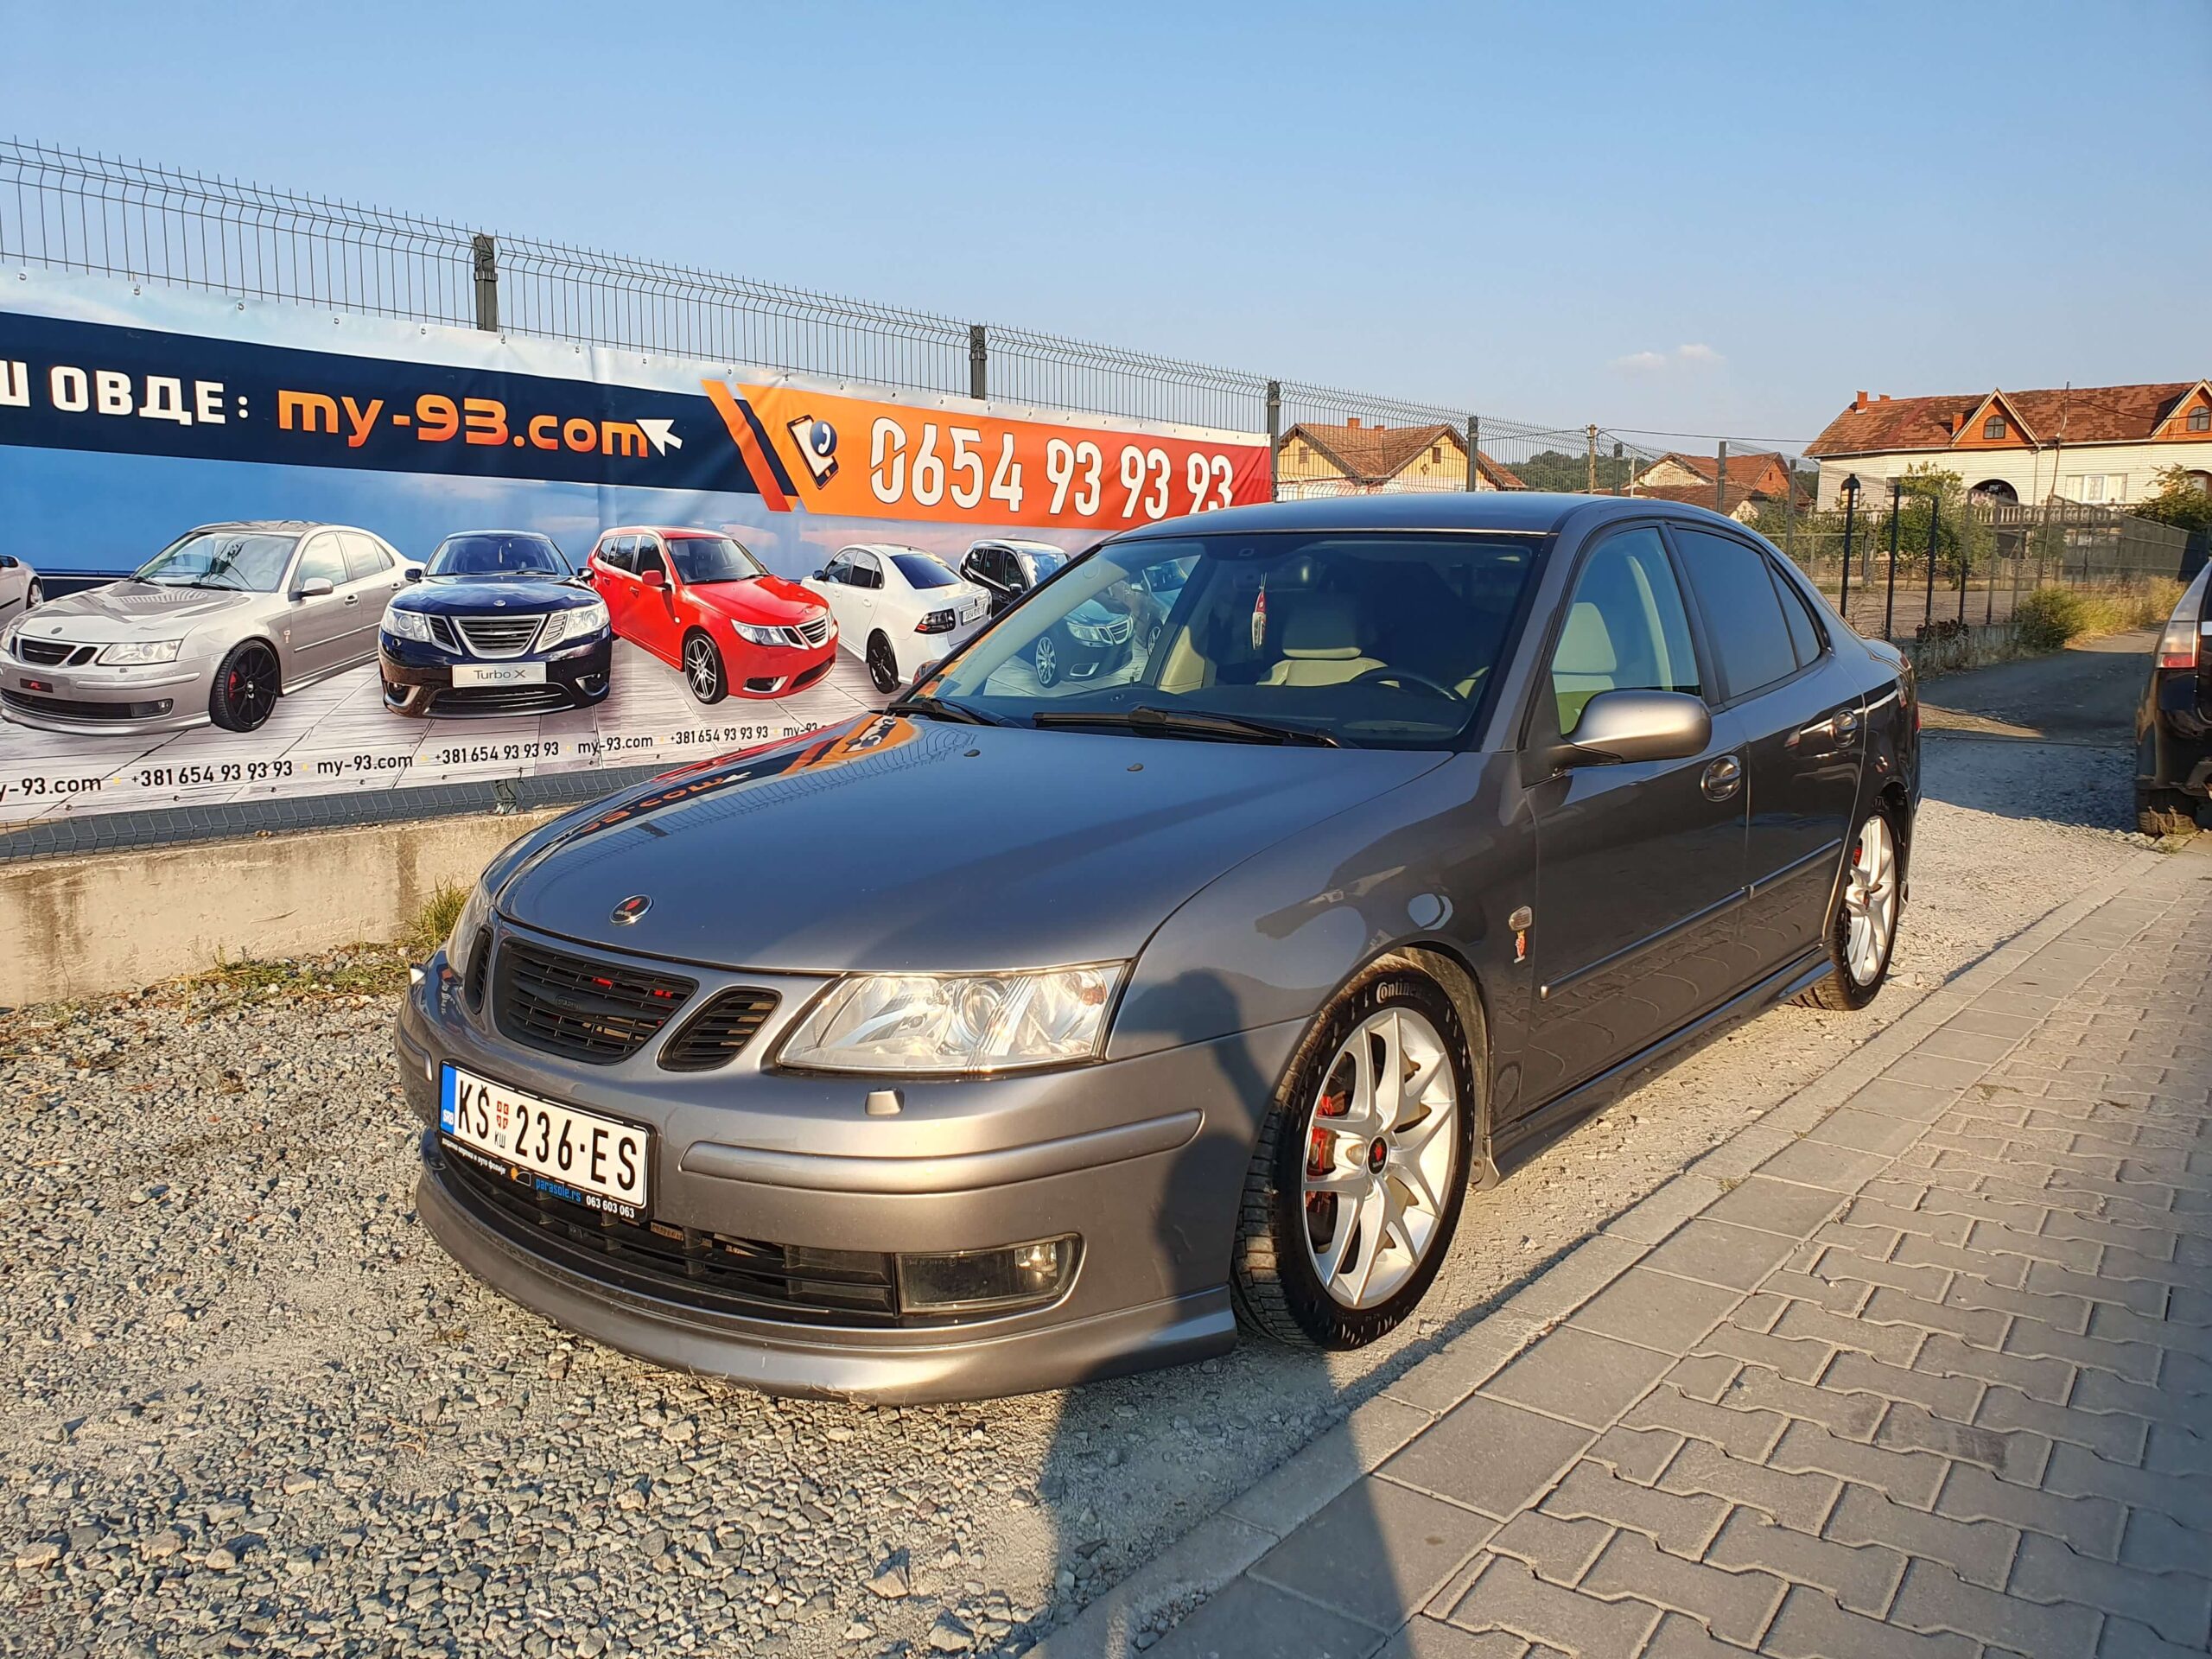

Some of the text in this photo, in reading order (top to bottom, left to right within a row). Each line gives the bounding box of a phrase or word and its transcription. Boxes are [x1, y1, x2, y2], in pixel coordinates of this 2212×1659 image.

[278, 390, 649, 457] my-93.com
[870, 416, 1234, 519] 0654 93 93 93
[474, 670, 525, 679] Turbo X
[131, 768, 174, 787] +381
[178, 766, 215, 784] 654
[220, 764, 241, 781] 93
[247, 762, 268, 780] 93
[273, 760, 293, 778] 93
[317, 754, 413, 776] my-93.com
[435, 749, 467, 764] +381
[471, 746, 499, 761] 654
[504, 744, 519, 759] 93
[524, 743, 539, 758] 93
[543, 741, 559, 756] 93
[578, 736, 654, 756] my-93.com
[671, 730, 695, 745] +381
[698, 728, 721, 742] 654
[724, 728, 737, 741] 93
[741, 727, 753, 740] 93
[756, 726, 768, 739] 93
[459, 1080, 490, 1140] KŠ
[535, 1178, 635, 1219] parasole.rs 063 603 063
